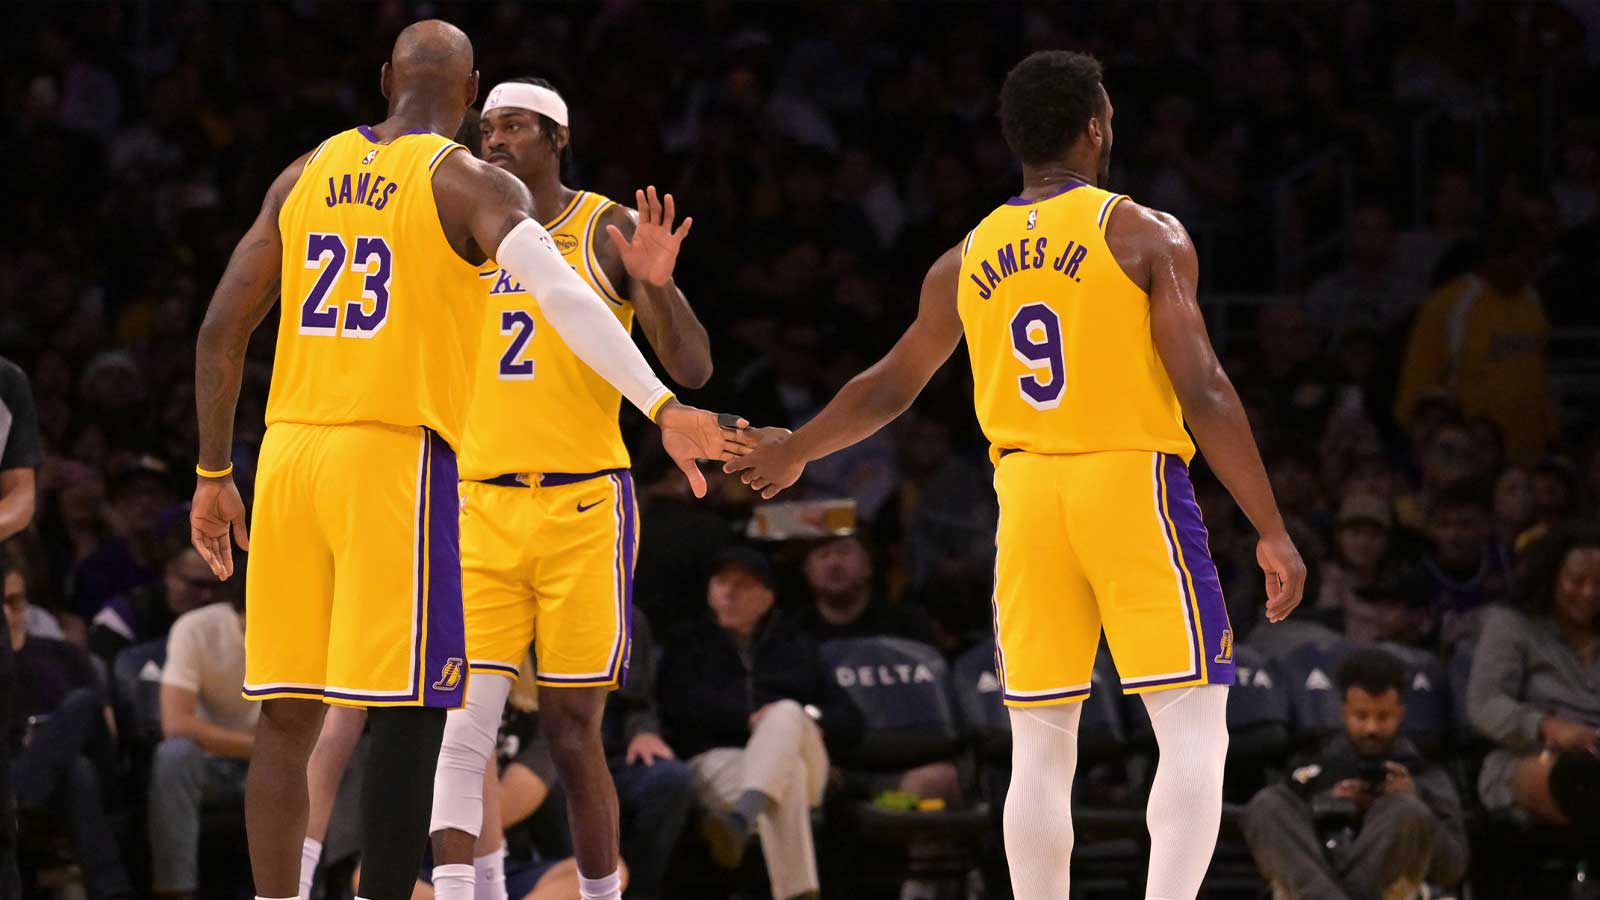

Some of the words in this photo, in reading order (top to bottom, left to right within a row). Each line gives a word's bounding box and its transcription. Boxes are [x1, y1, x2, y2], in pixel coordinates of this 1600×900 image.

[325, 172, 397, 211] JAMES
[298, 232, 392, 339] 23
[970, 236, 1048, 300] JAMES
[1053, 240, 1088, 283] JR.
[498, 310, 535, 380] 2
[1009, 300, 1067, 411] 9
[835, 664, 934, 688] DELTA
